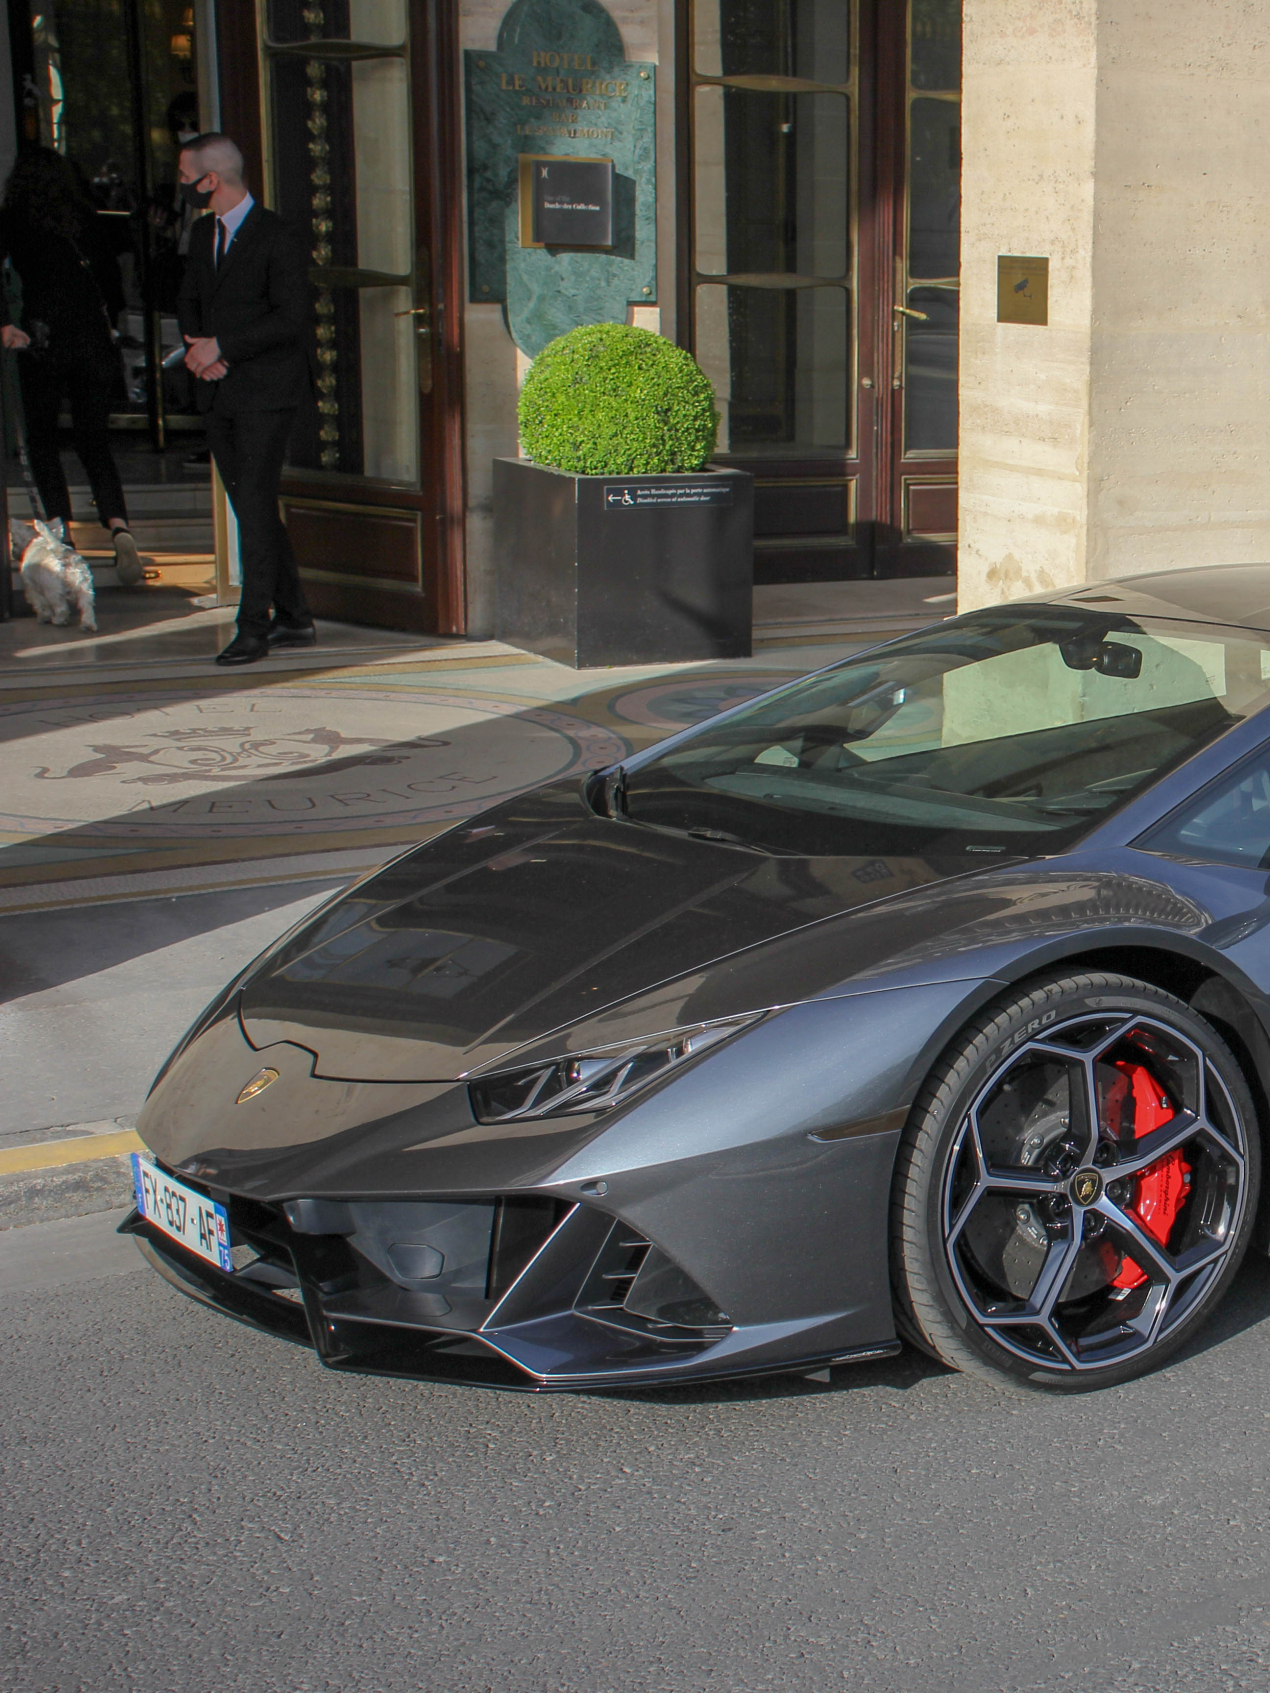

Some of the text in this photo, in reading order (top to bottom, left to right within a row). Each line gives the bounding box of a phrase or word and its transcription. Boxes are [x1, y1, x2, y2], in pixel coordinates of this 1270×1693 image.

[532, 50, 598, 71] HOTEL
[501, 73, 628, 98] LE MEURICE
[521, 94, 607, 111] RESTAURANT
[552, 111, 579, 124] BAR
[37, 702, 283, 728] HOTEL
[125, 771, 498, 815] MEURICE
[1000, 1010, 1057, 1056] ZERO
